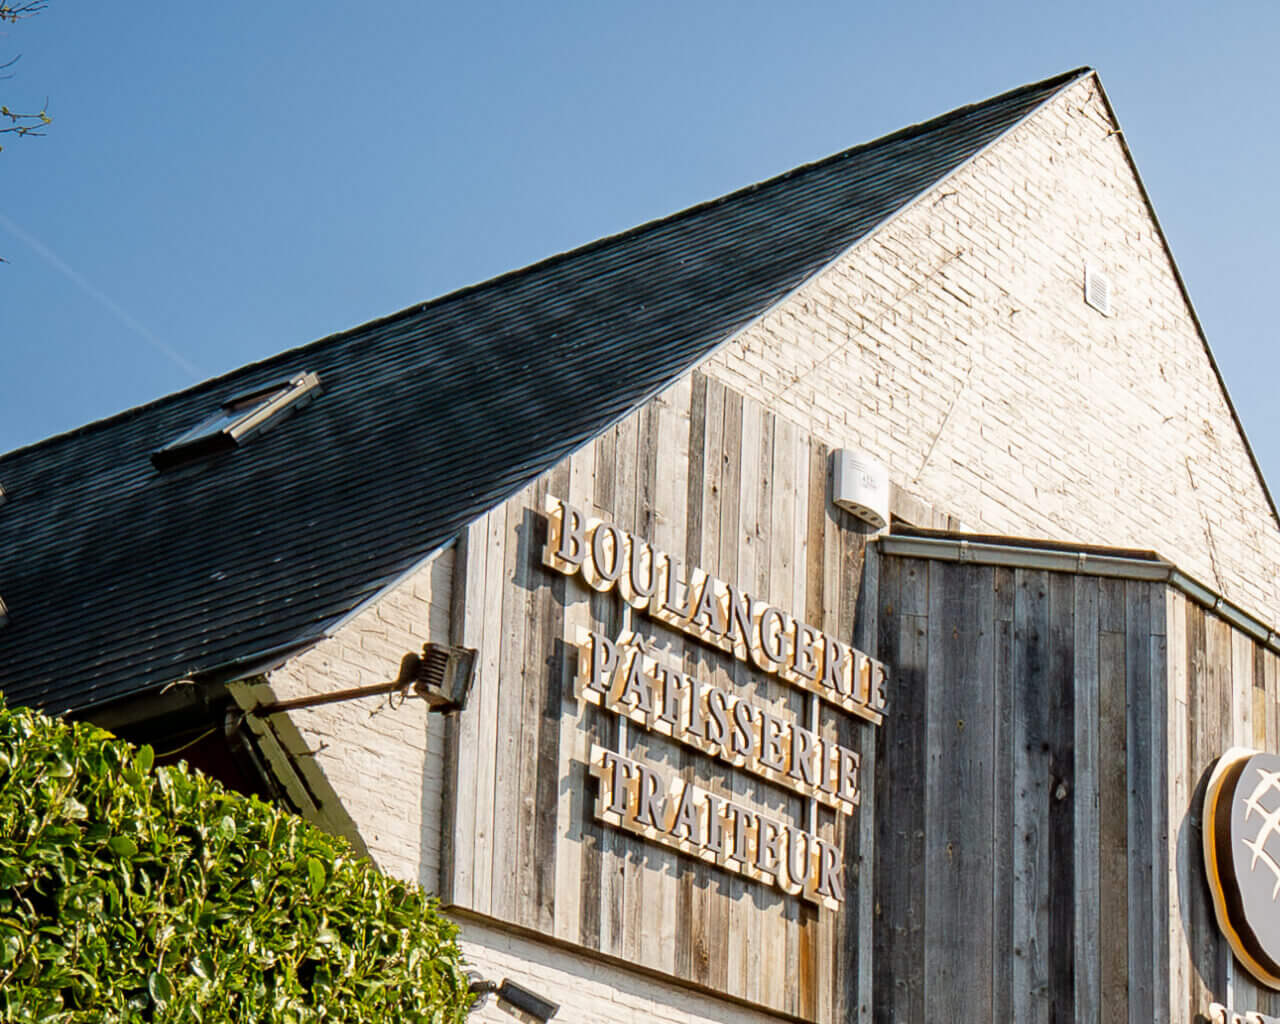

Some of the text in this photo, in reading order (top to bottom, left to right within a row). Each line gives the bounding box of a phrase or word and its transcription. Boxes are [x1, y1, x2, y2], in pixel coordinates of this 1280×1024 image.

[550, 495, 890, 721] BOULANGERIE
[581, 627, 861, 810] PÂTISSERIE
[595, 748, 845, 905] TRAITEUR
